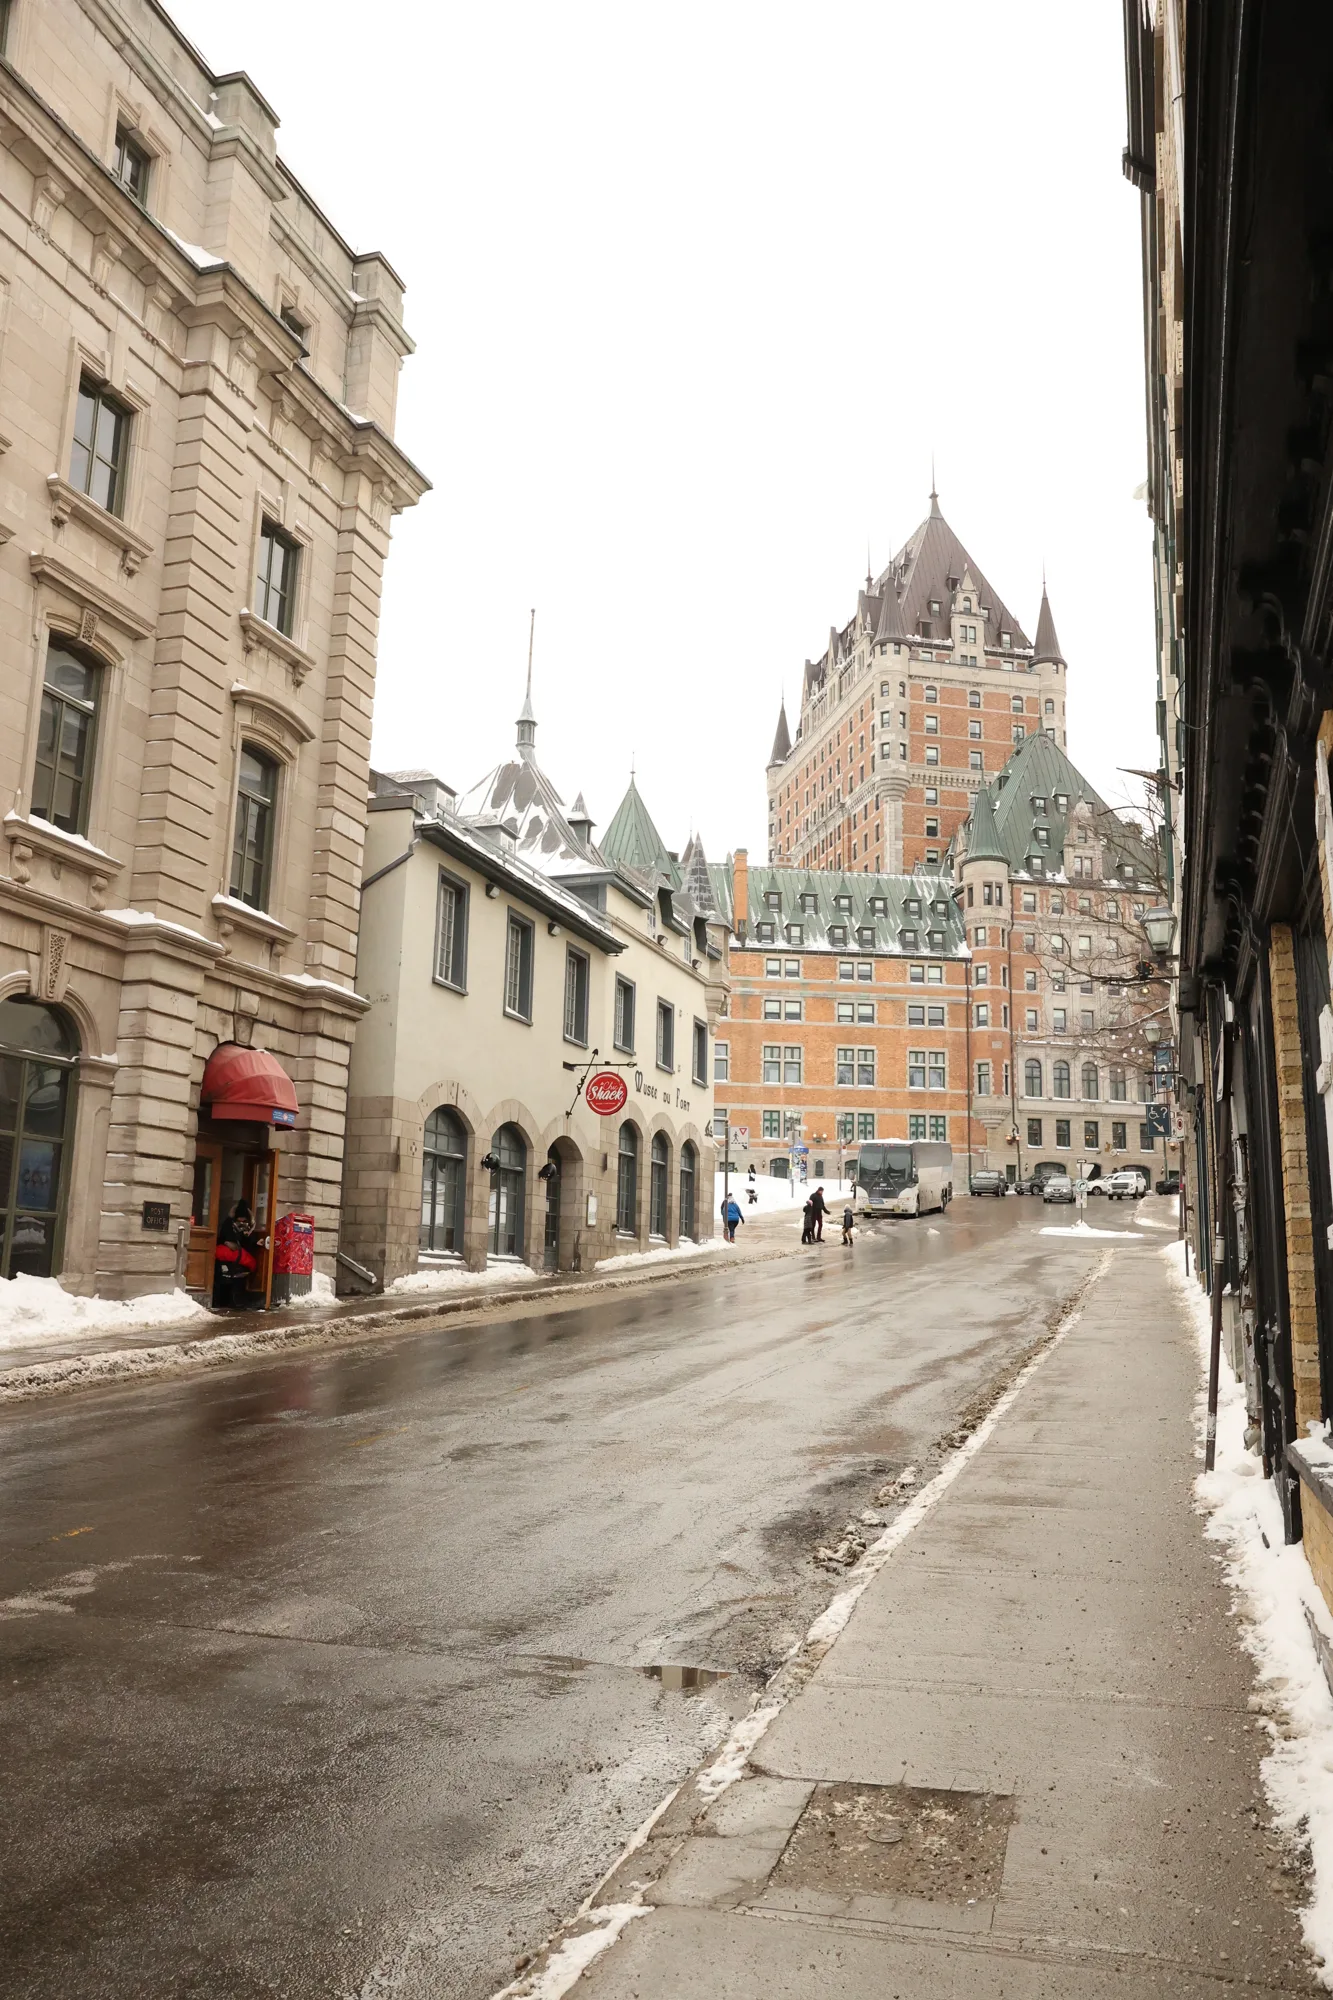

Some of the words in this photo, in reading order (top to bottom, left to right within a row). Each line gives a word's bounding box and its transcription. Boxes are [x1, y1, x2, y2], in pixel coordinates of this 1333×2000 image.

[587, 1085, 624, 1101] Shack
[150, 1207, 164, 1215] POST
[146, 1216, 168, 1225] OFFICE
